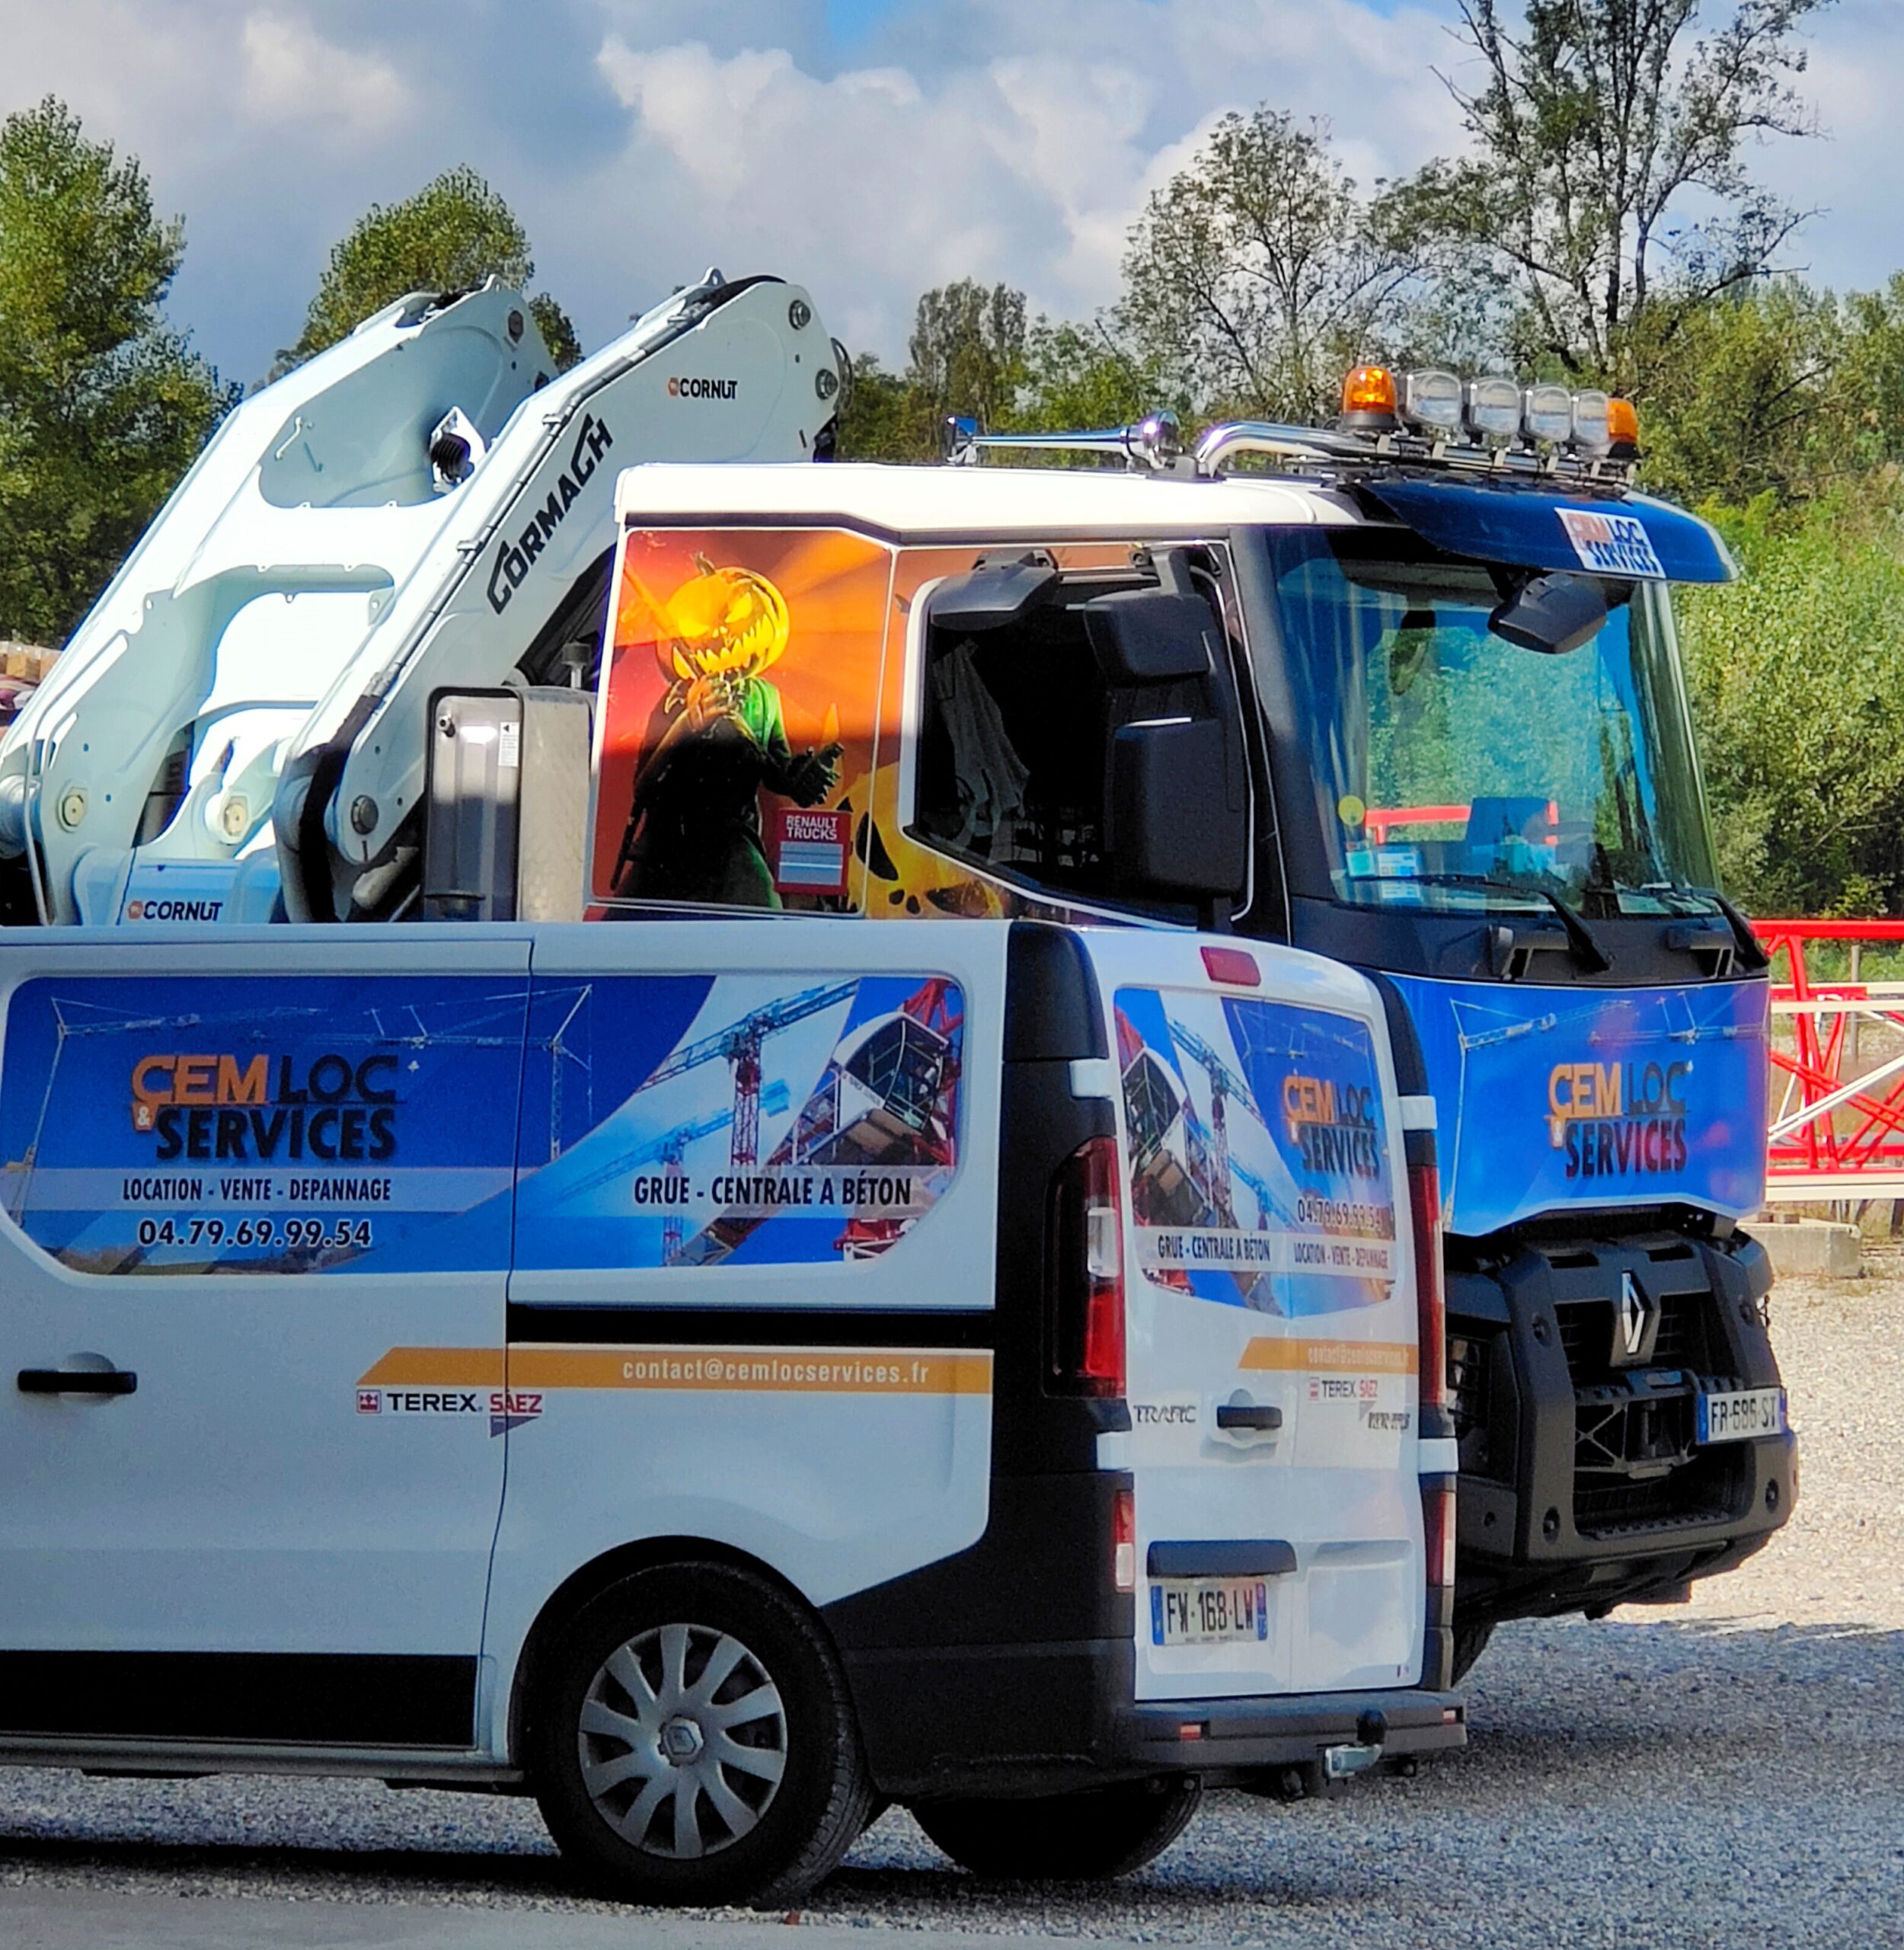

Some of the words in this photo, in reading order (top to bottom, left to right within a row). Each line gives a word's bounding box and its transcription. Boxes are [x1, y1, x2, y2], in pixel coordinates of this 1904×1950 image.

[680, 379, 738, 400] CORNUT
[486, 413, 613, 615] CORMACH
[1605, 518, 1648, 547] LOC
[786, 815, 838, 830] RENAULT
[786, 827, 838, 841] TRUCKS
[143, 900, 224, 922] CORNUT
[131, 1054, 269, 1104] CEM
[278, 1054, 399, 1103] LOC
[1548, 1061, 1622, 1117] CEM
[1628, 1060, 1686, 1114] LOC
[1283, 1076, 1334, 1124] CEM
[156, 1108, 396, 1160] SERVICES
[1299, 1125, 1380, 1180] SERVICES
[1565, 1117, 1687, 1180] SERVICES
[123, 1178, 202, 1201] LOCATION
[220, 1178, 271, 1201] VENTE
[289, 1178, 391, 1201] DEPANNAGE
[634, 1176, 690, 1205] GRUE
[711, 1177, 813, 1205] CENTRALE
[819, 1177, 835, 1205] A
[842, 1170, 912, 1206] BÉTON
[138, 1220, 371, 1247] 04.79.69.99.54
[1158, 1235, 1184, 1259] GRUE
[1192, 1236, 1234, 1260] CENTRALE
[622, 1358, 929, 1383] contact@cemlocservices.fr
[1321, 1379, 1356, 1398] TEREX
[388, 1393, 478, 1412] TEREX
[490, 1393, 542, 1413] SAEZ
[1133, 1404, 1197, 1424] TRAFIC
